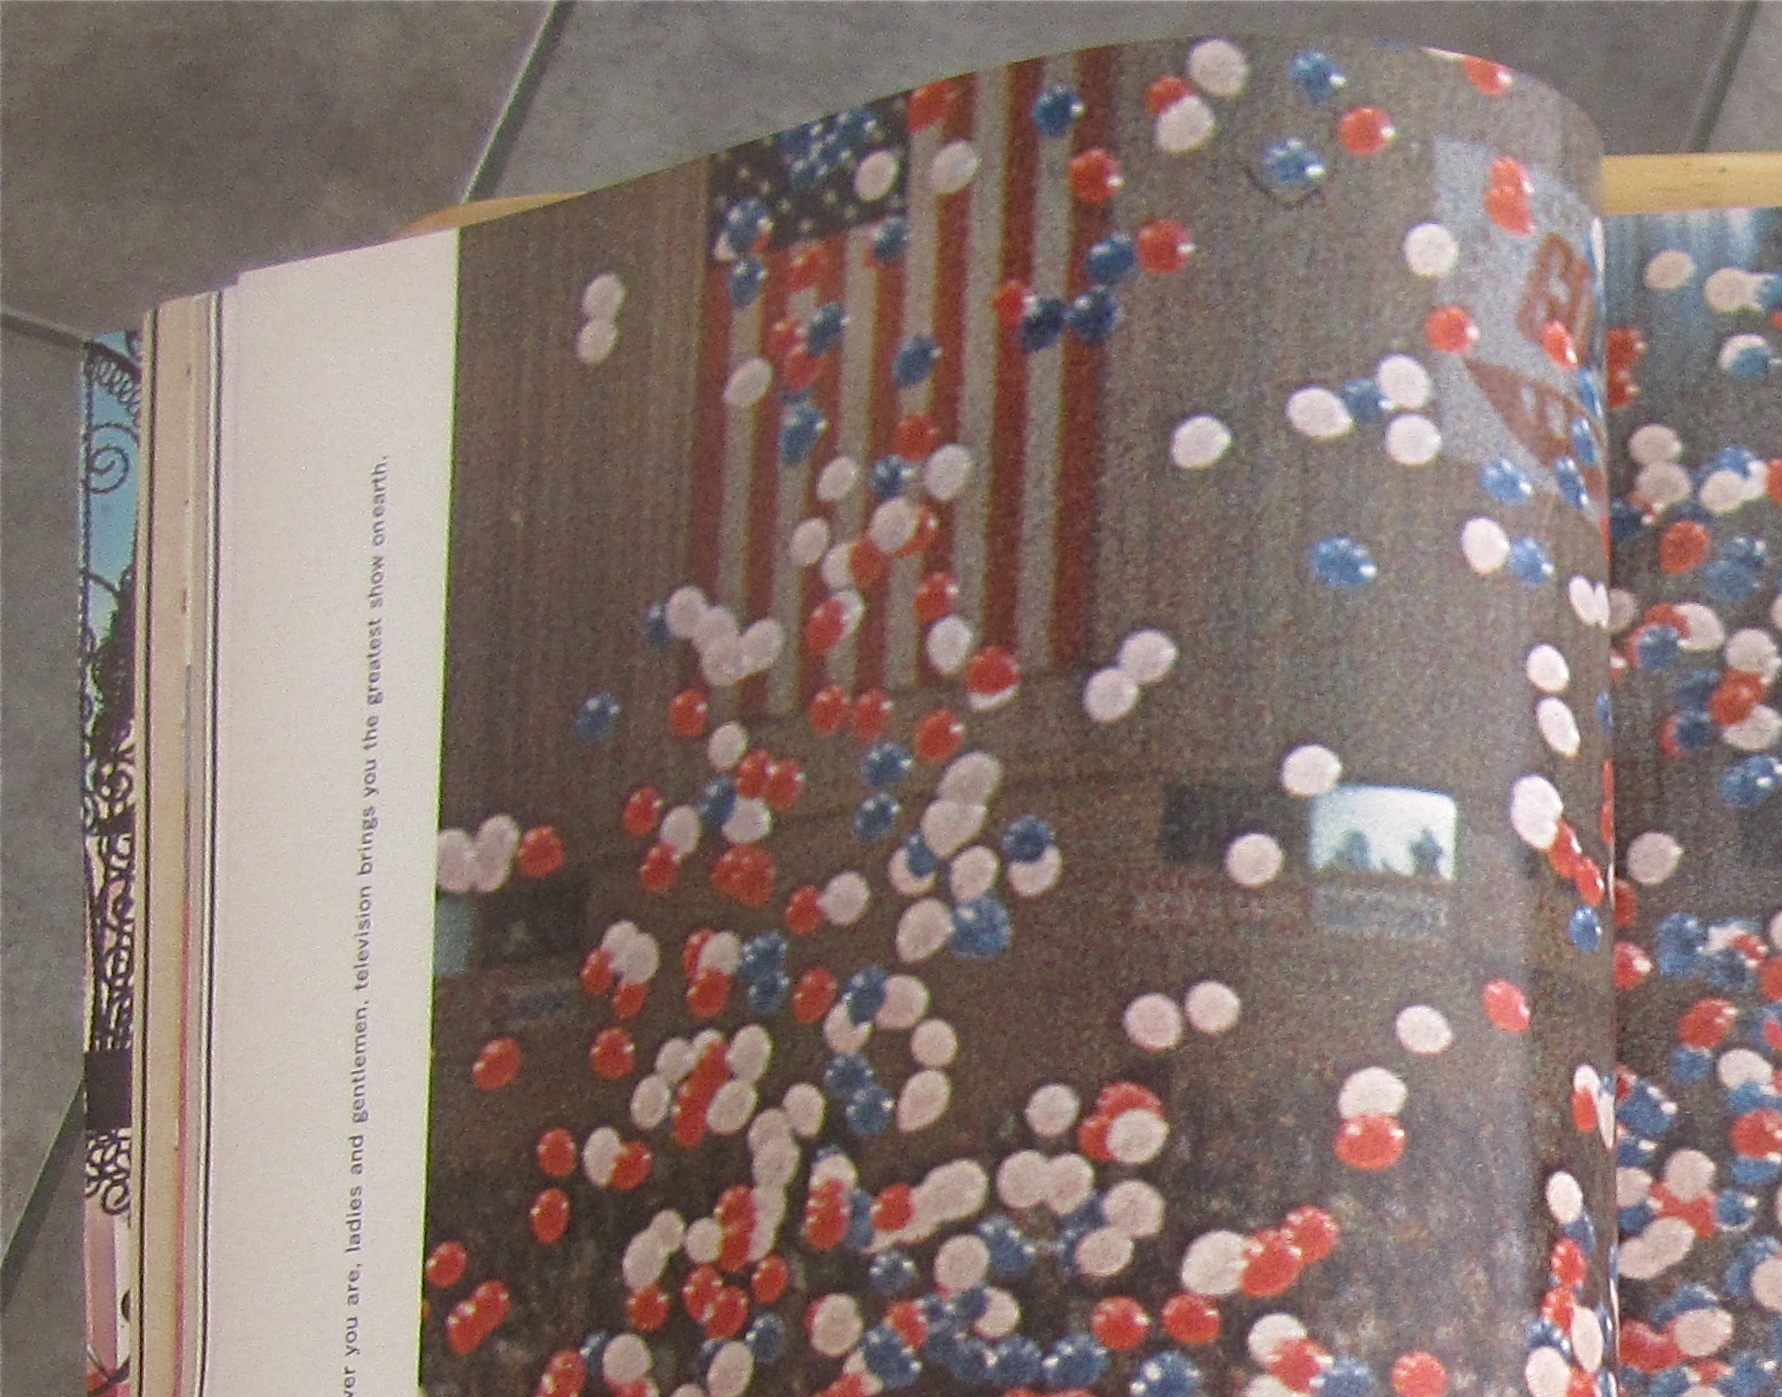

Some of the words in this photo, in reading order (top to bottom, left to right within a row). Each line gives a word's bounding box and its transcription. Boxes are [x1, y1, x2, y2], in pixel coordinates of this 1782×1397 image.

[367, 555, 385, 609] show
[365, 618, 383, 706] greatest
[361, 715, 379, 751] the
[363, 758, 380, 798] you
[356, 805, 379, 876] brings
[352, 885, 372, 992] television
[351, 1000, 370, 1124] gentlemen,
[347, 1134, 364, 1175] and
[344, 1185, 363, 1254] ladies
[346, 1263, 363, 1307] are,
[344, 1316, 361, 1357] you
